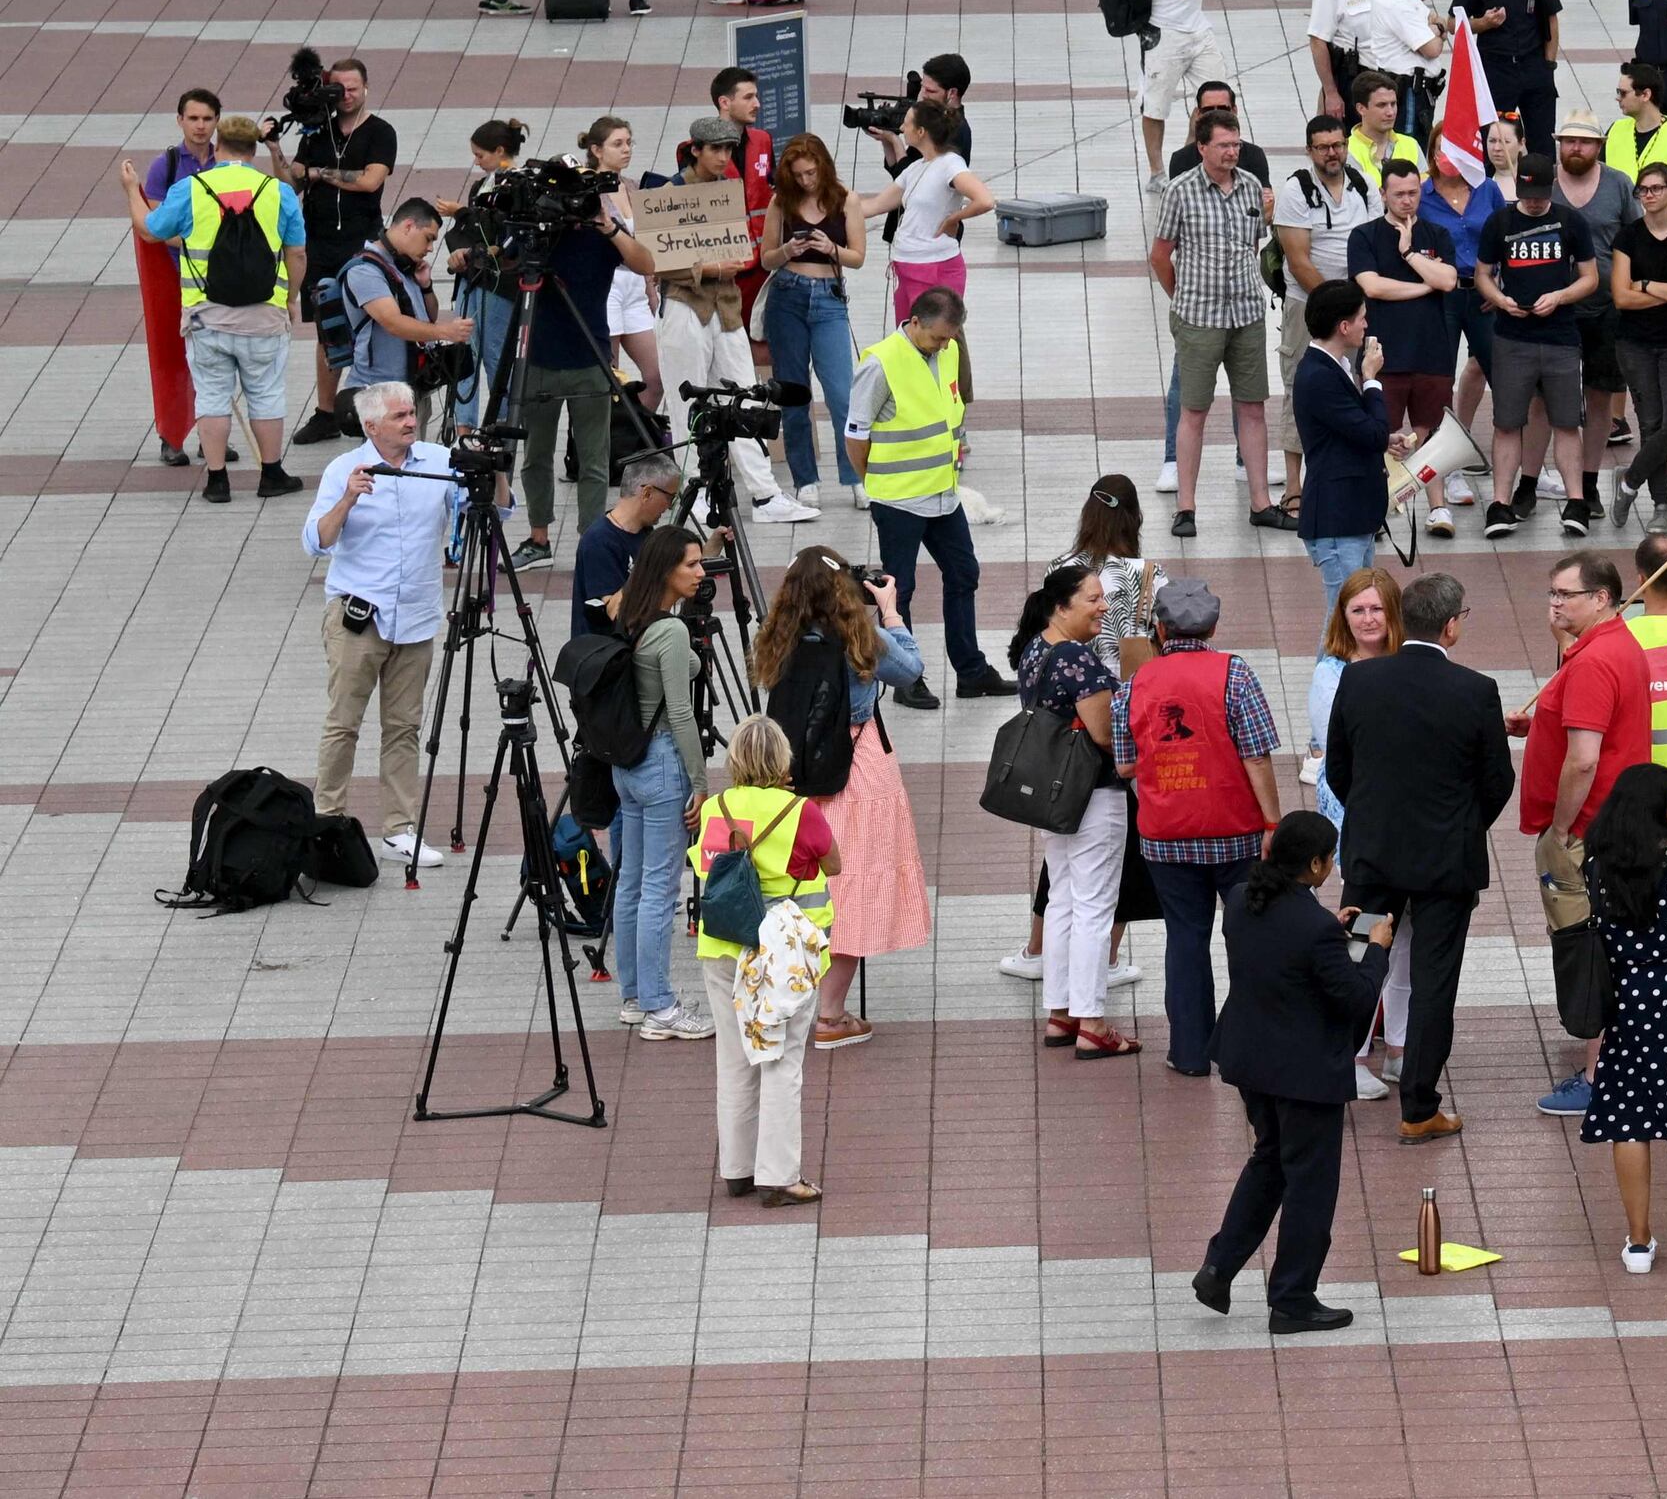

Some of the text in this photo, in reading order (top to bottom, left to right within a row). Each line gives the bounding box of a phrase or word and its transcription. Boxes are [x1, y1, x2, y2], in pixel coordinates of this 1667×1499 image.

[643, 194, 730, 215] Solidarität mit
[678, 213, 708, 225] allen
[656, 227, 749, 254] Streikenden
[1510, 251, 1561, 260] JONES
